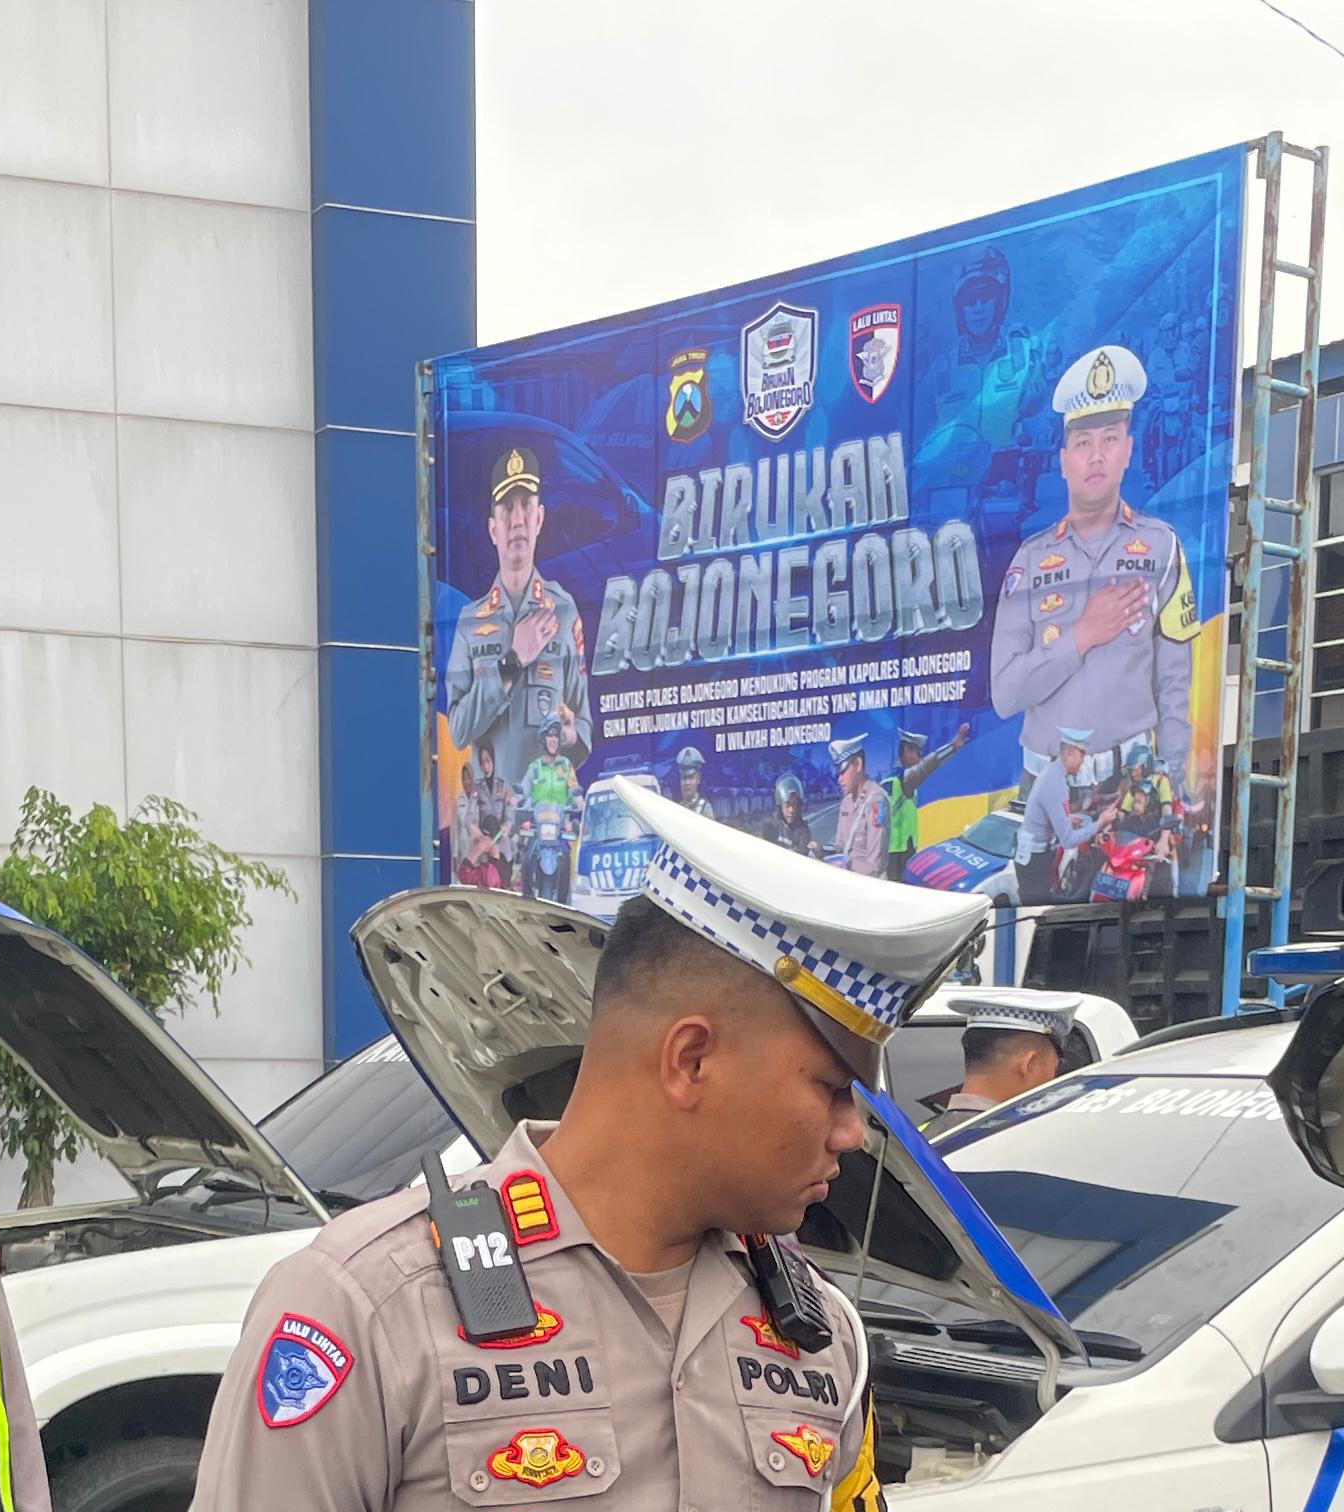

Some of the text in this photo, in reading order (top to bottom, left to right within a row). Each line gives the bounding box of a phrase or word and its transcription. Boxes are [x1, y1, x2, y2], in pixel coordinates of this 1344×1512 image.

[658, 432, 909, 561] BIRUKAN
[1032, 568, 1070, 589] DENI
[1115, 558, 1156, 574] POLRI
[592, 519, 984, 676] BOJONEGORO
[600, 650, 972, 713] SATLANTAS POLRES BOJONEGORO MENDUKUNG PROGRAM KAPOLRES BOJONEGORO
[603, 718, 627, 738] GUNA
[690, 707, 726, 729] SITUASI
[831, 691, 857, 714] YANG
[858, 688, 889, 711] AMAN
[890, 685, 913, 708] DAN
[913, 679, 967, 705] KONDUSIF
[726, 728, 769, 751] WILAYAH
[769, 722, 831, 747] BOJONEGORO
[936, 840, 991, 871] POLISI
[452, 1231, 514, 1271] P12
[283, 1319, 347, 1367] LALU LINTAS
[453, 1356, 594, 1405] DENI
[736, 1356, 839, 1406] POLRI
